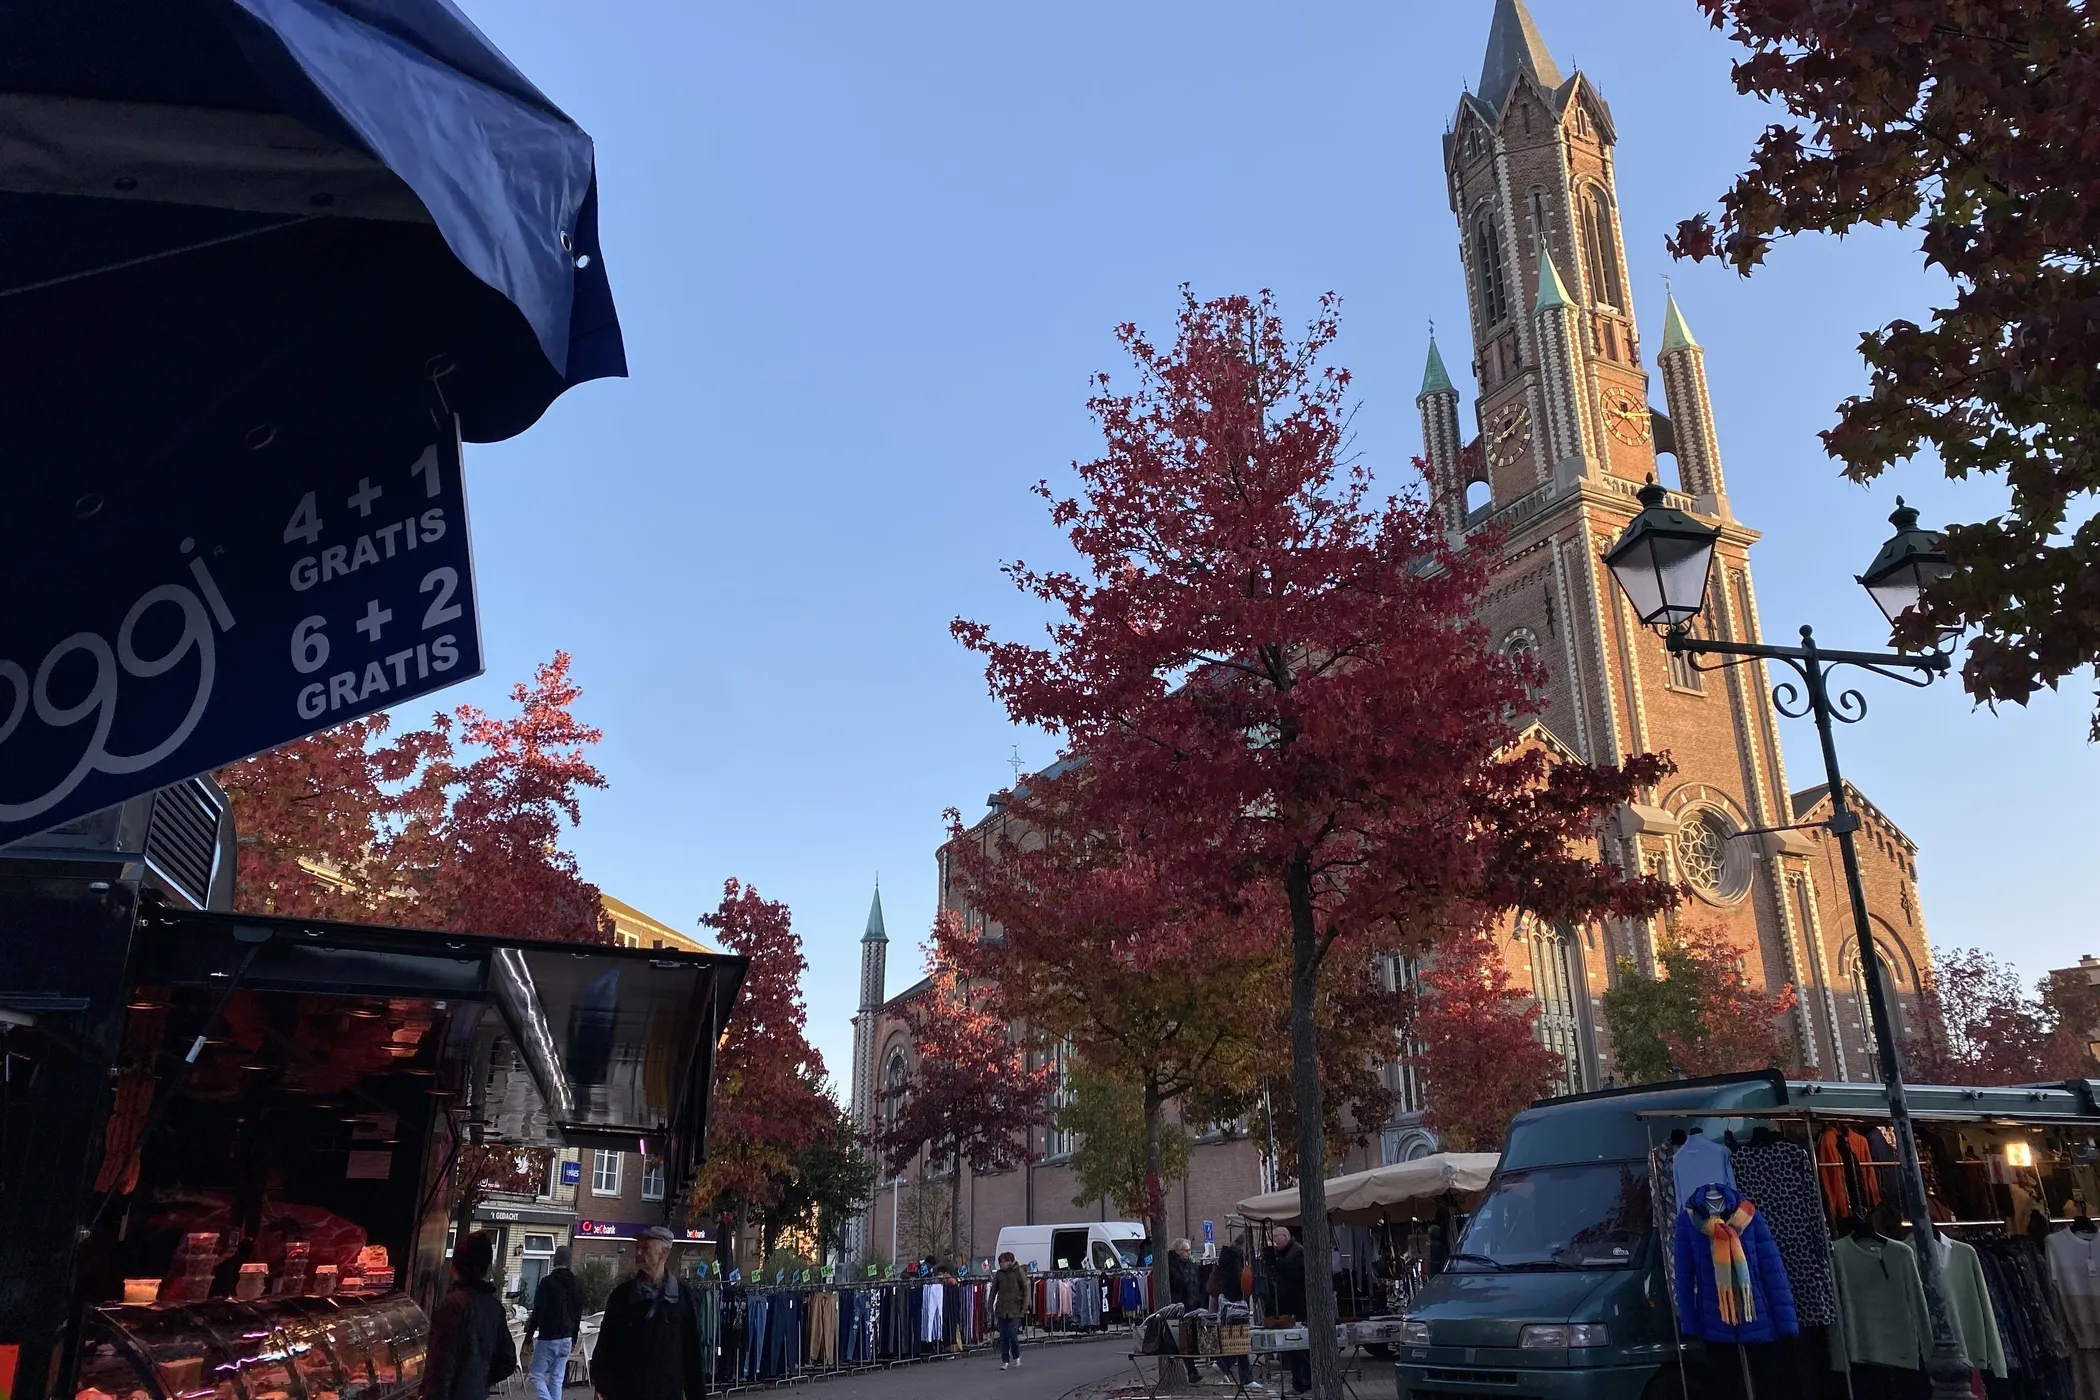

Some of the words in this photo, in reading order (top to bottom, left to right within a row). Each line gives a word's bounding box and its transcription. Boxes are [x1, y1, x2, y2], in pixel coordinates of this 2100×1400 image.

[284, 490, 324, 545] 4
[347, 476, 382, 518] +
[410, 443, 442, 499] 1
[289, 507, 448, 592] GRATIS
[290, 615, 330, 674] 6
[356, 598, 393, 643] +
[419, 566, 463, 631] 2
[296, 634, 460, 720] GRATIS
[495, 1212, 519, 1220] GEDACHT
